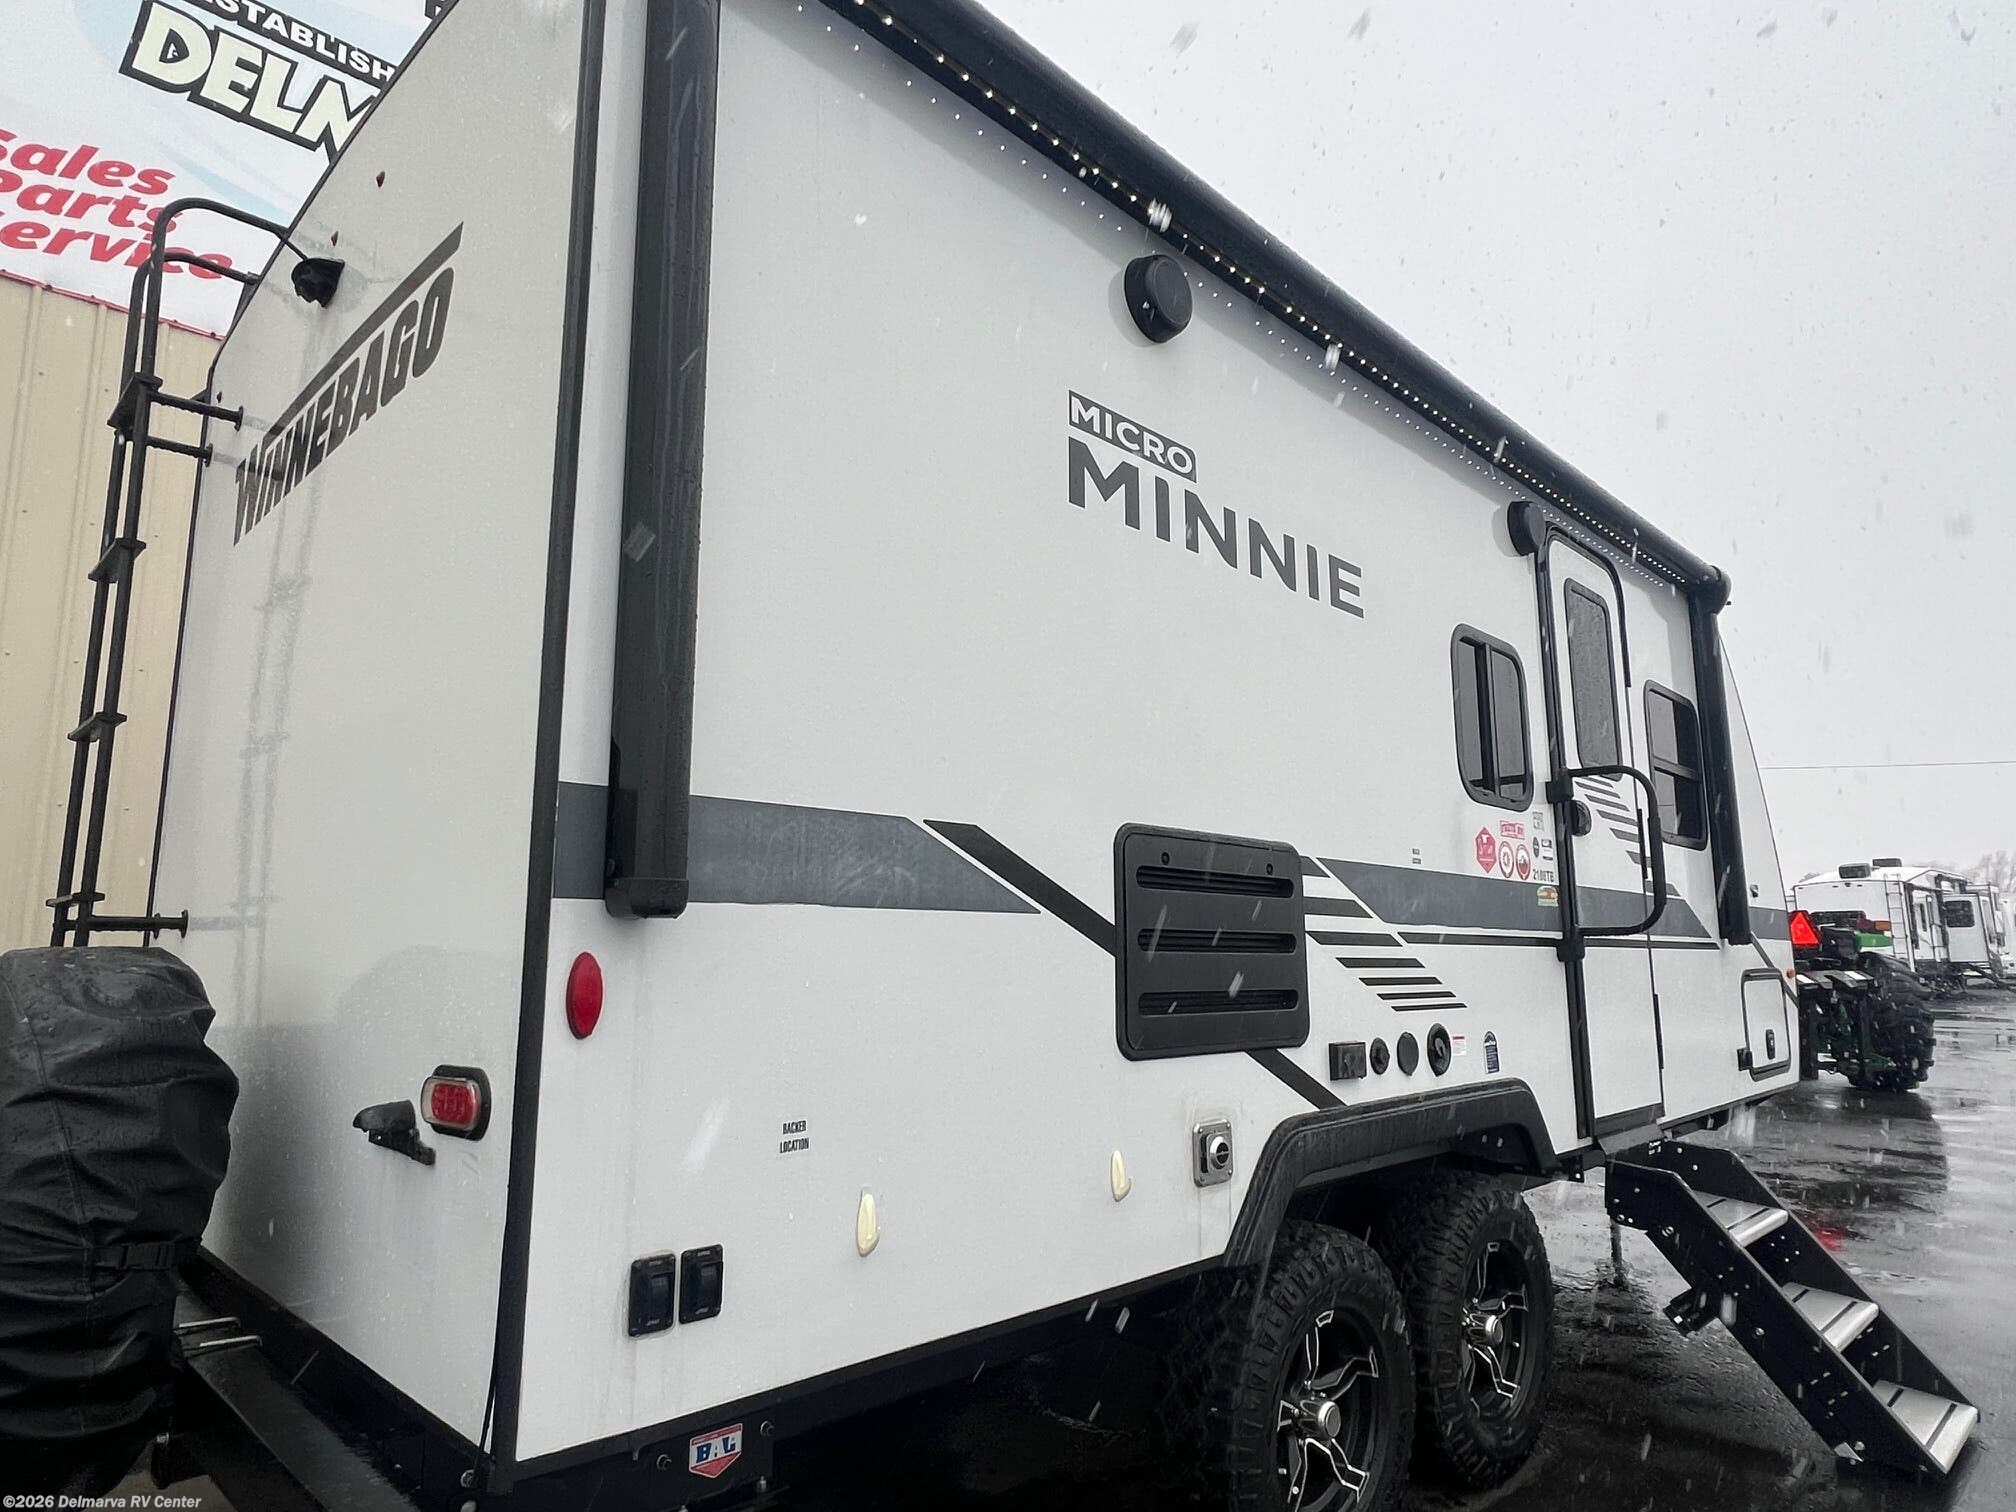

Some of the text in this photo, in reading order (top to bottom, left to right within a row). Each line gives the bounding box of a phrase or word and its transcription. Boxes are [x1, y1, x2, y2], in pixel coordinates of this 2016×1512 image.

[206, 0, 396, 82] STABLISH
[233, 266, 455, 547] WINNEBAGO
[1070, 395, 1194, 476] MICRO
[1068, 436, 1365, 619] MINNIE
[779, 1137, 809, 1154] LOCATION
[782, 1120, 807, 1135] BACKER
